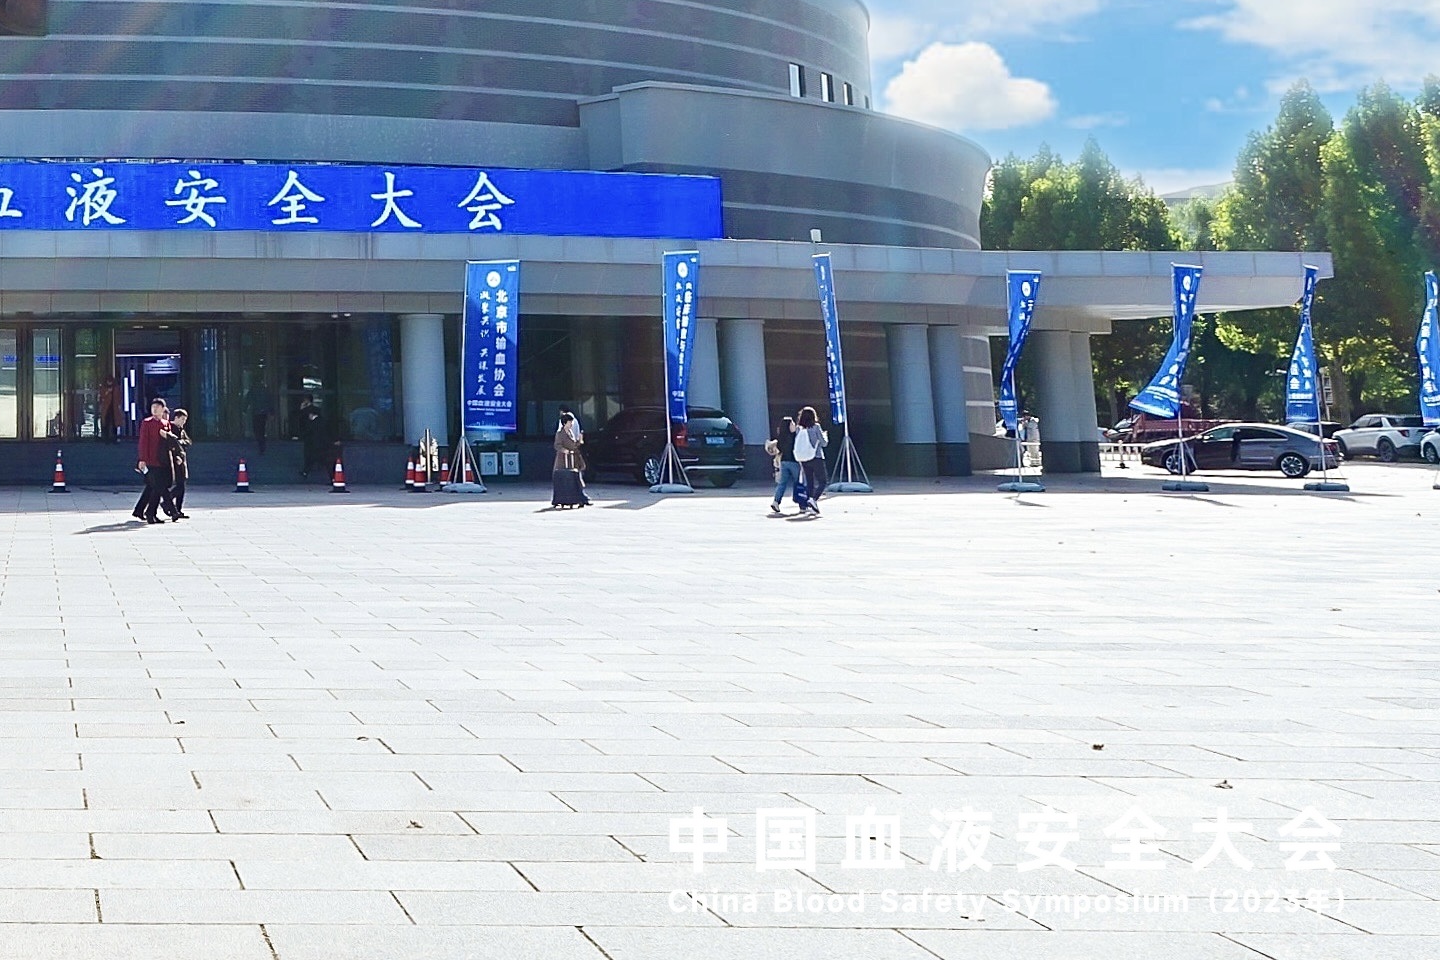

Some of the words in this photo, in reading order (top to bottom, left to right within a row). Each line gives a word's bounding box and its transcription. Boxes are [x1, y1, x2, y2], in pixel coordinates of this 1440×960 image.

[493, 289, 508, 397] 北京市输血协会
